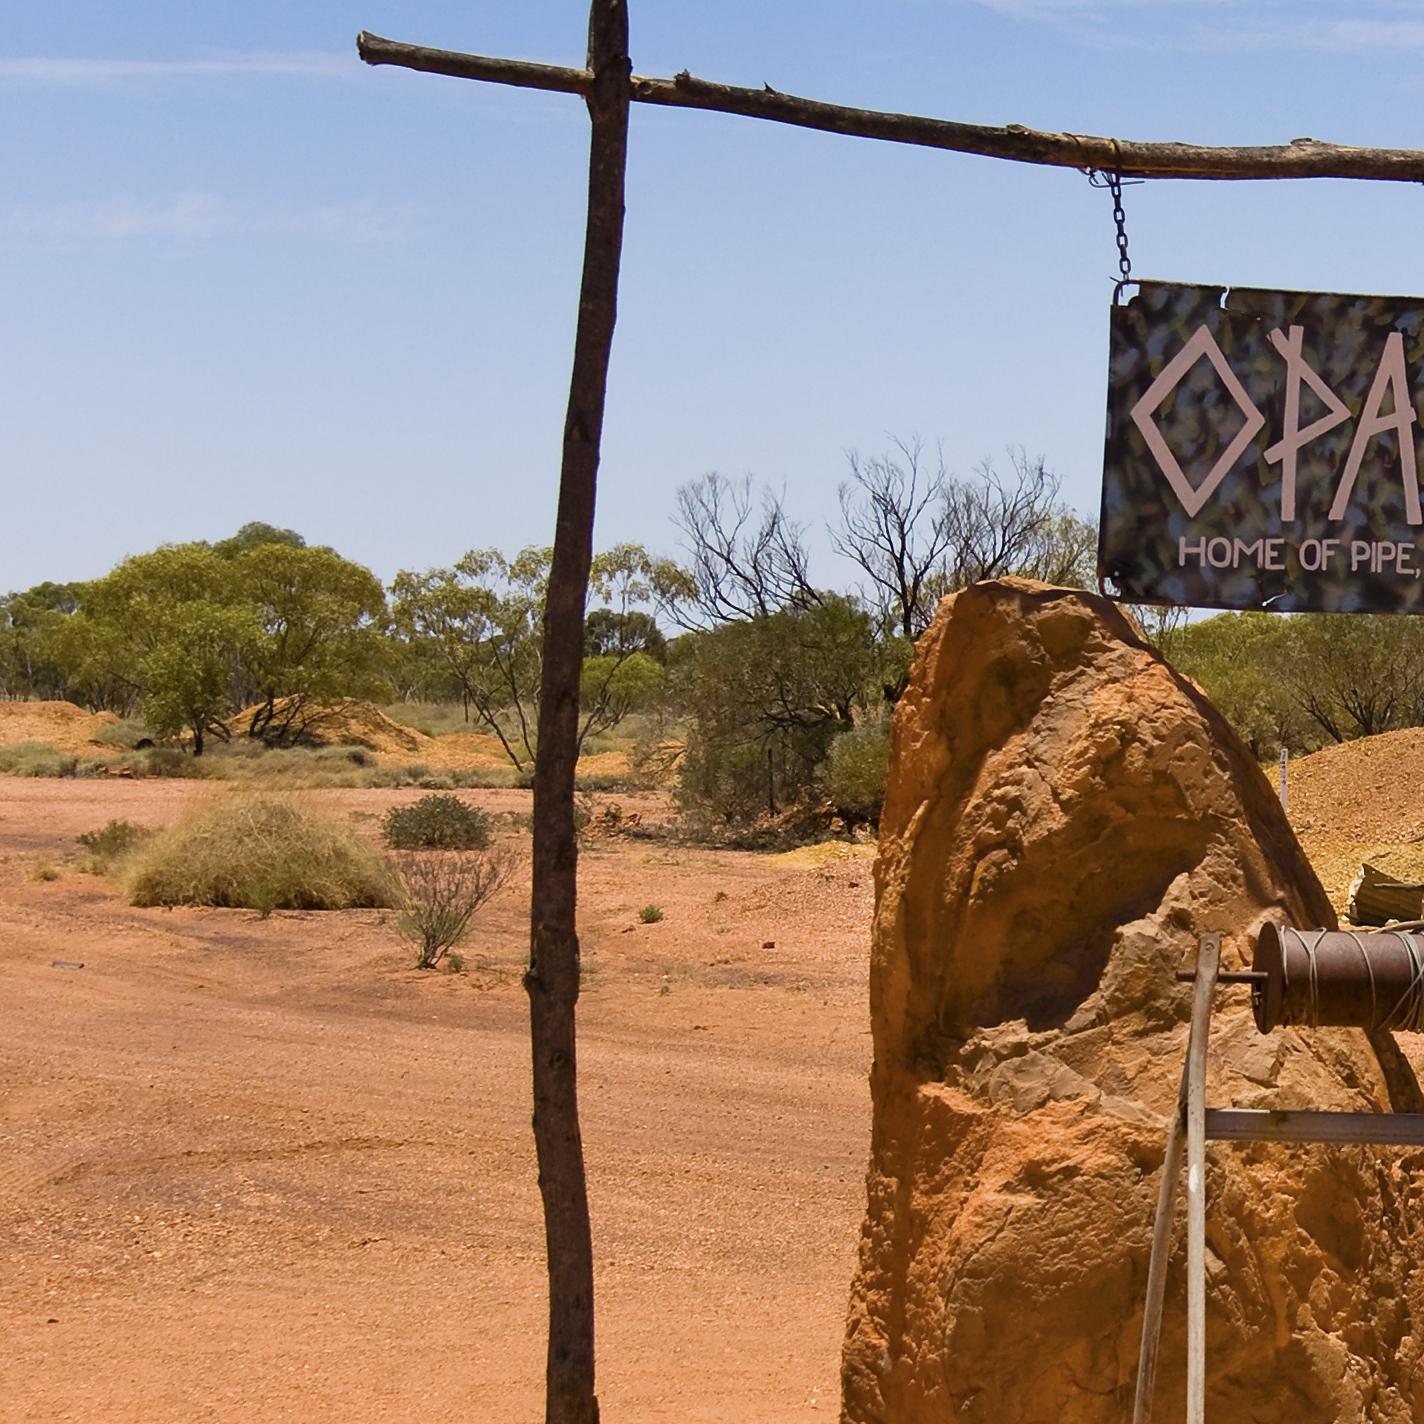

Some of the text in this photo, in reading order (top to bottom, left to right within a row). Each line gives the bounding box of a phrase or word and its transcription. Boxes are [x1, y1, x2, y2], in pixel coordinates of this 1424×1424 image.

[1179, 536, 1285, 570] HOME
[1300, 538, 1340, 571] OF
[1351, 540, 1421, 578] PIPE,
